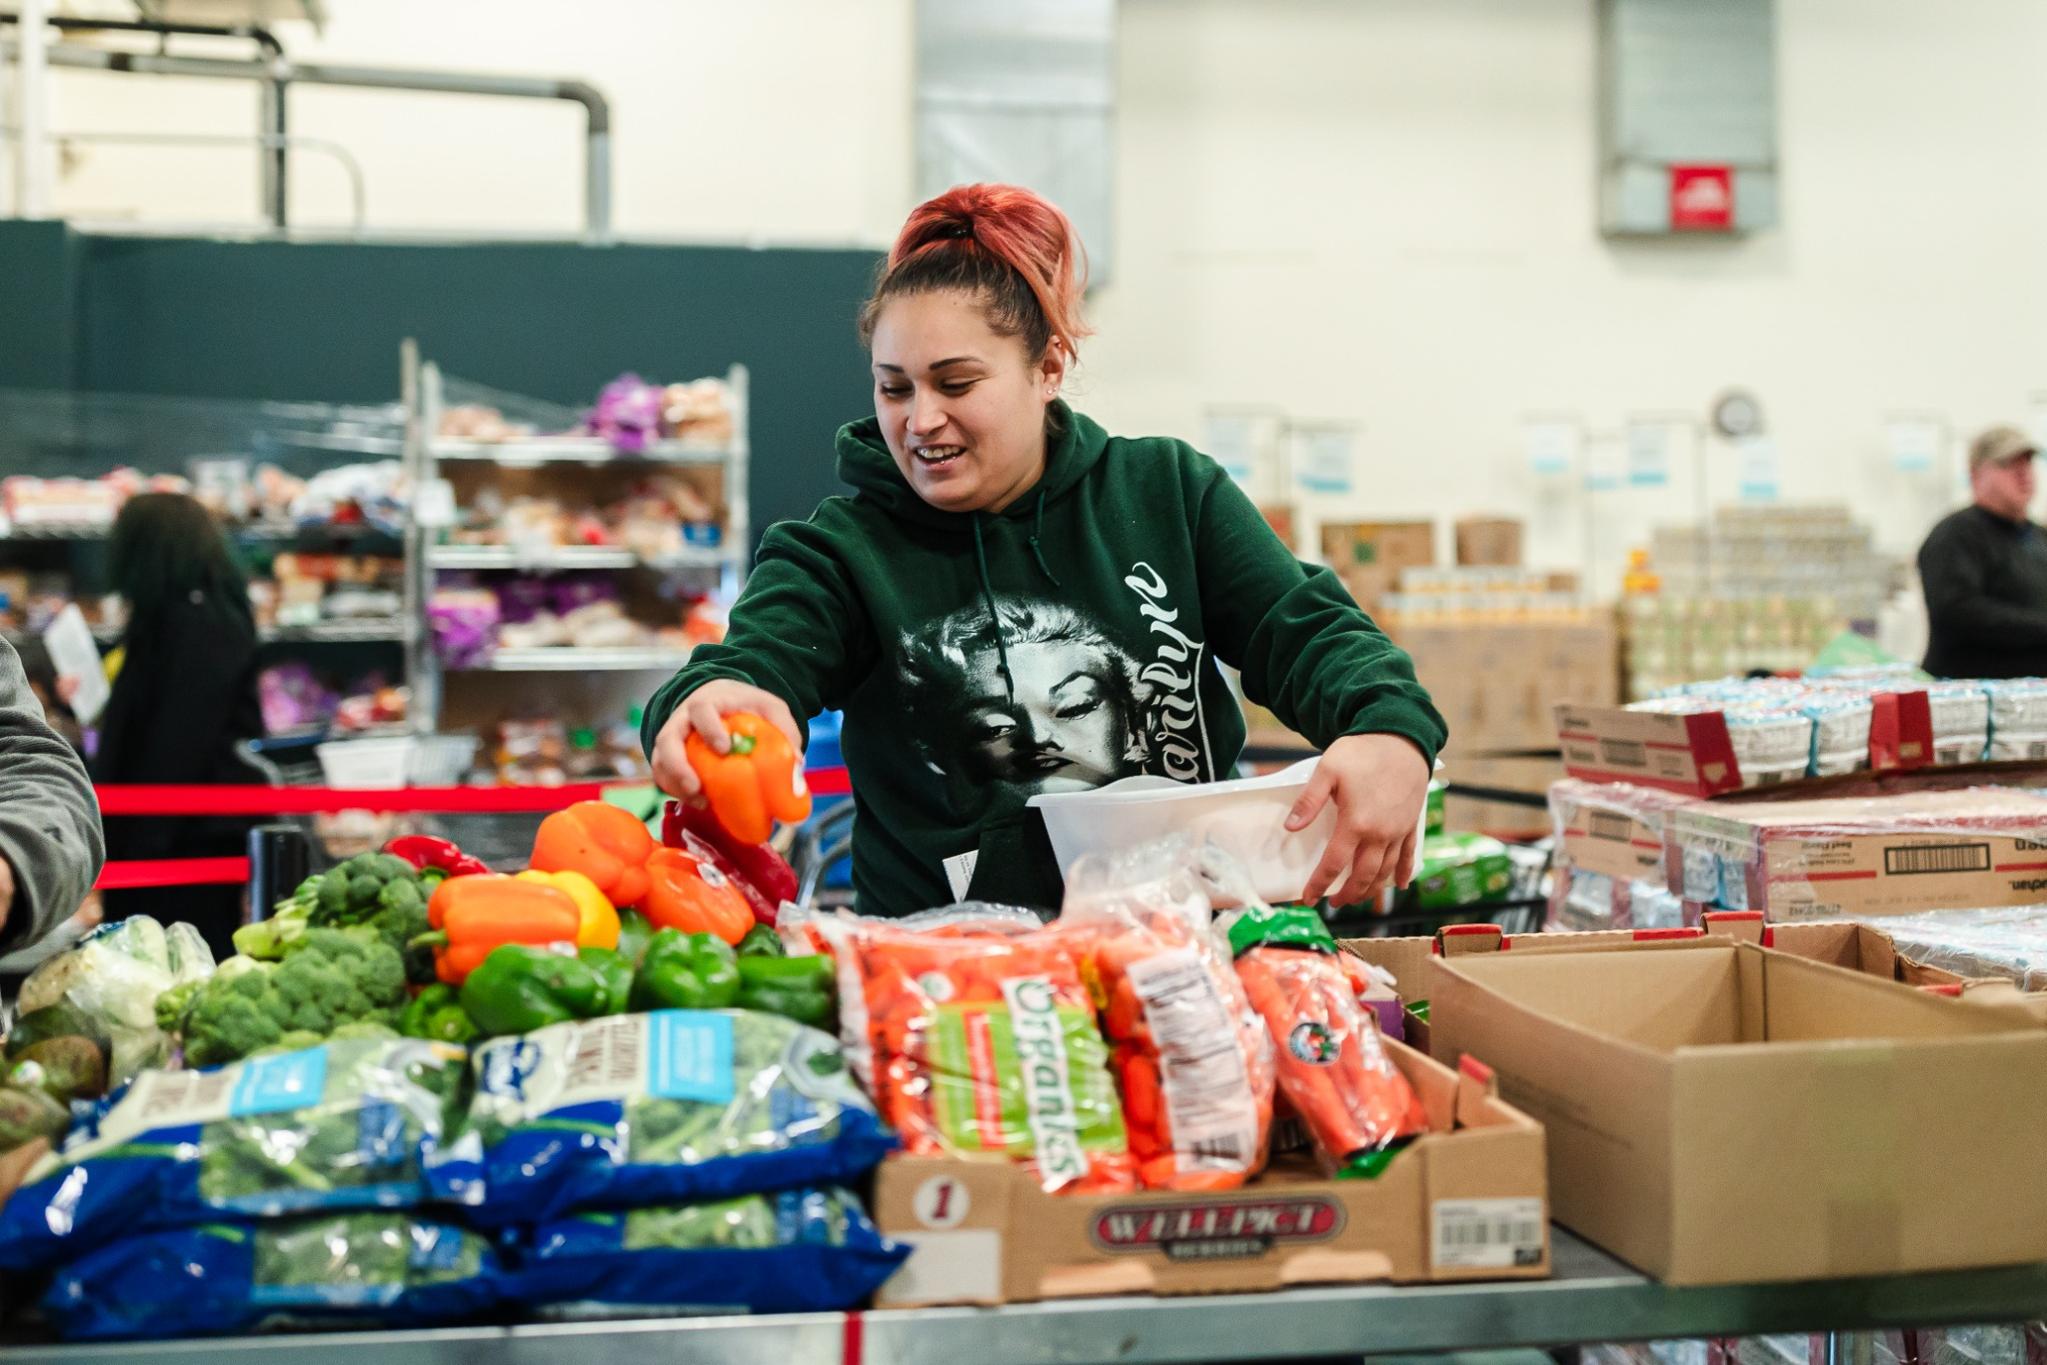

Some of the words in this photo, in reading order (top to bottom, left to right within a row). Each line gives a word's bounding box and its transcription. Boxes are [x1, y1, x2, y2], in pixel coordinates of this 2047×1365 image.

[1124, 561, 1215, 784] arilyn
[1014, 980, 1081, 1174] Organics
[930, 1183, 953, 1219] 1
